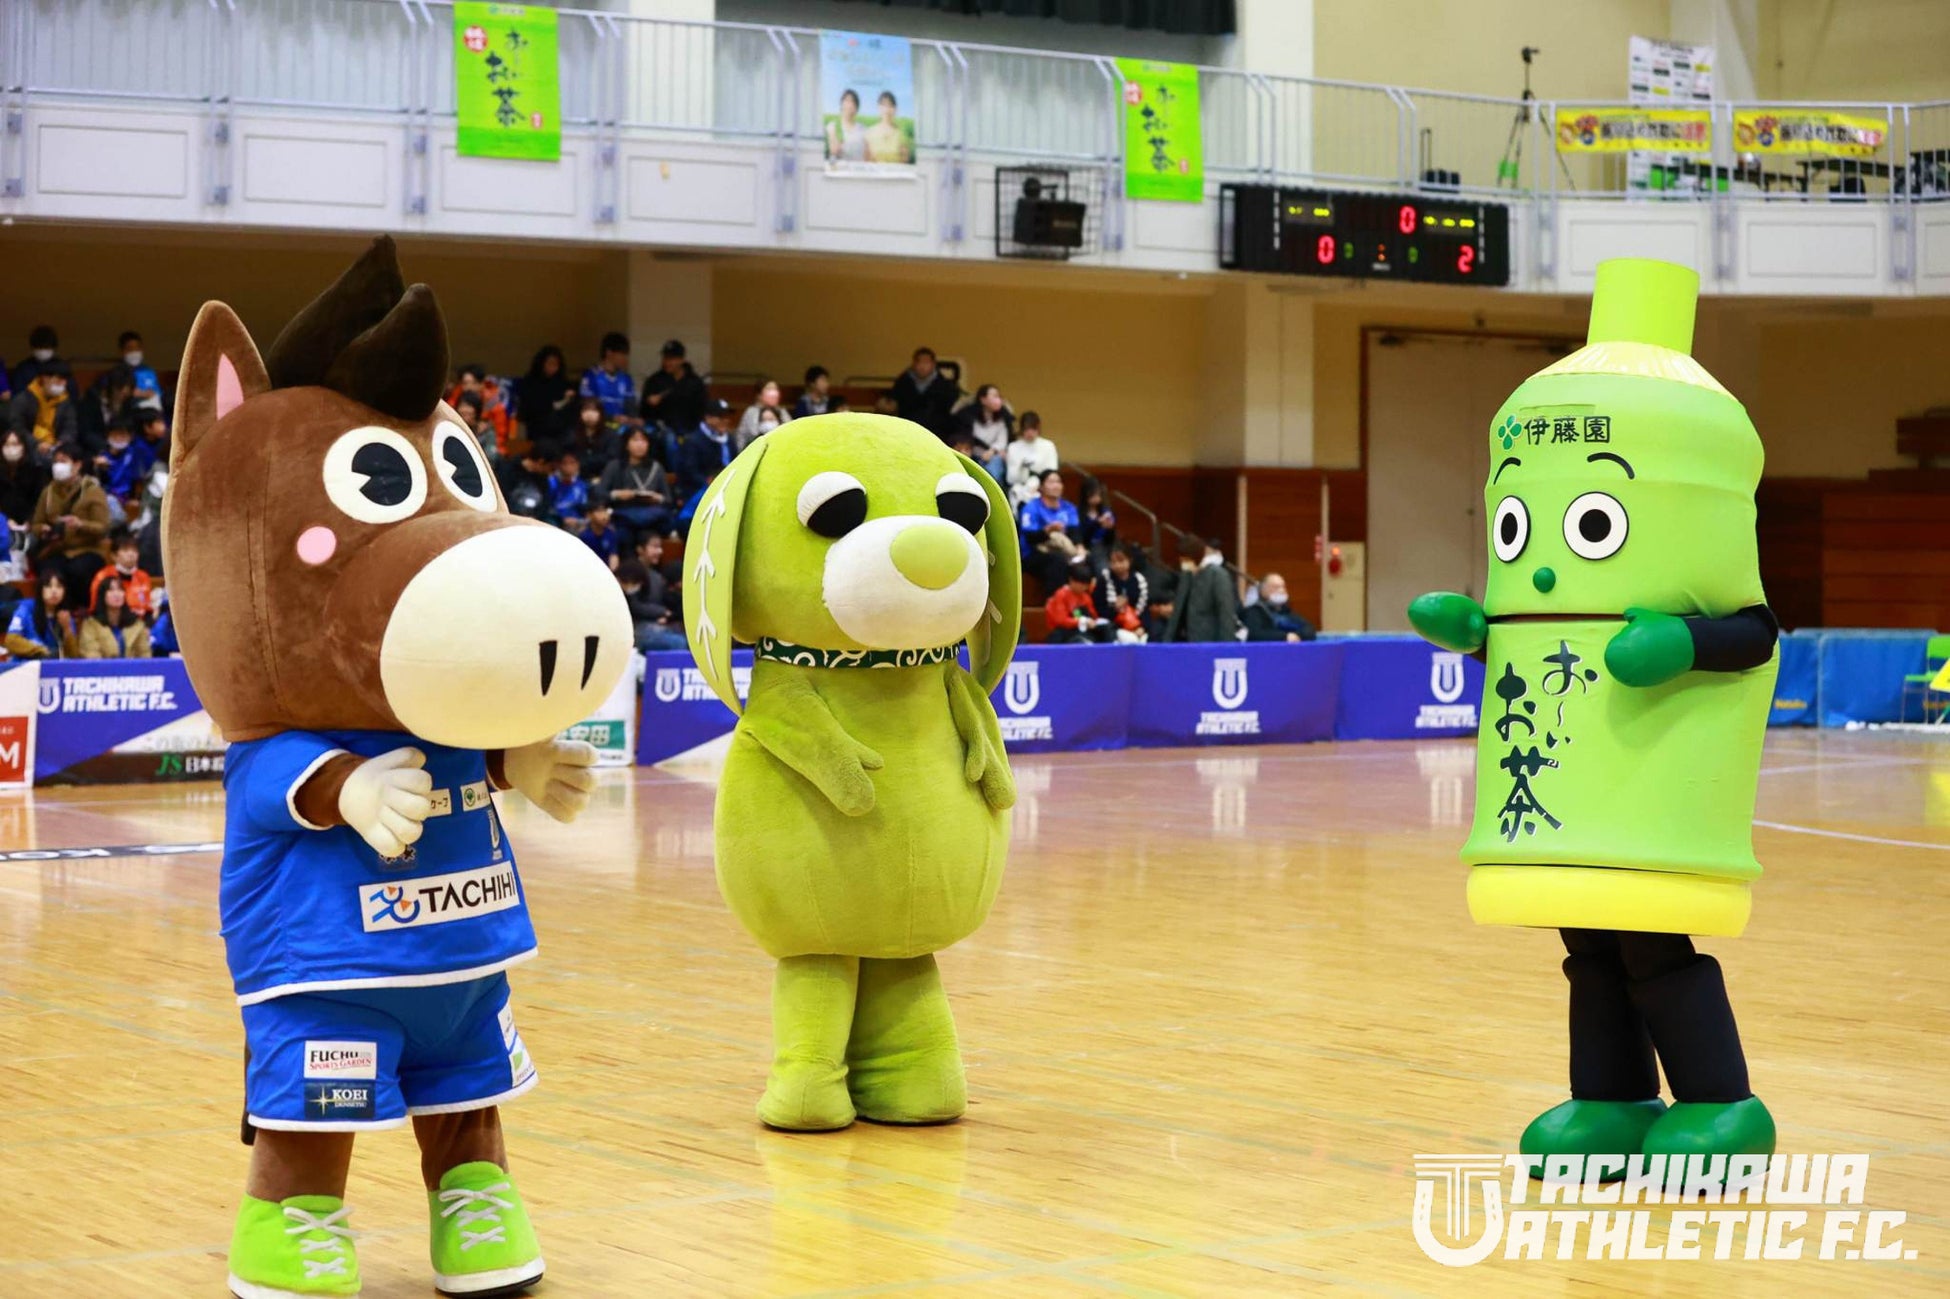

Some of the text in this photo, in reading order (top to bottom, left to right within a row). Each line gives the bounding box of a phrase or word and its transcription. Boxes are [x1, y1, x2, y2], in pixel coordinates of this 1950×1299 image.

[1400, 205, 1416, 235] 0
[1318, 235, 1335, 264] 0
[1458, 245, 1475, 273] 2
[1524, 416, 1611, 445] 伊藤園
[63, 675, 165, 693] TACHIKAWA
[62, 692, 178, 712] ATHLETIC F.C.
[418, 871, 516, 913] TACHIHI
[310, 1050, 358, 1062] FUCHU
[332, 1089, 368, 1101] KOEI
